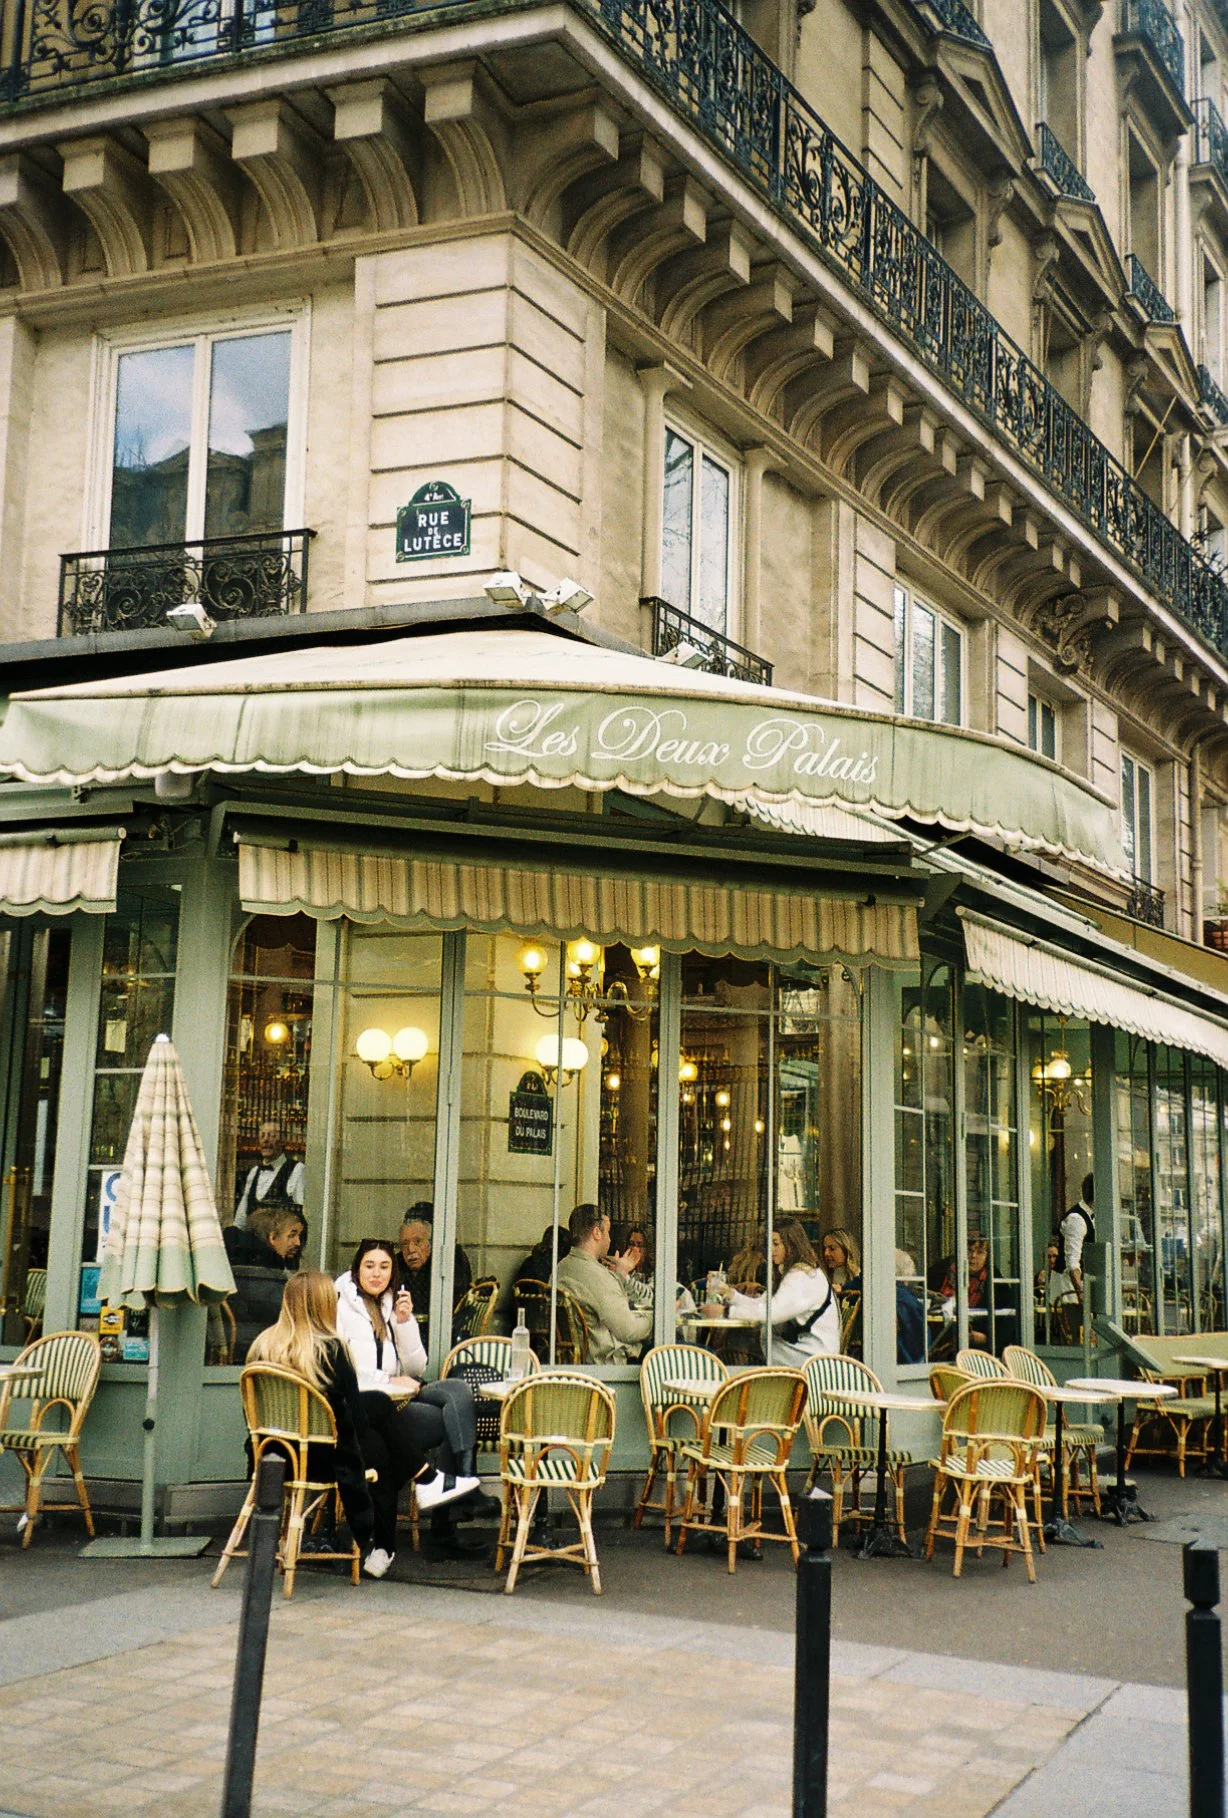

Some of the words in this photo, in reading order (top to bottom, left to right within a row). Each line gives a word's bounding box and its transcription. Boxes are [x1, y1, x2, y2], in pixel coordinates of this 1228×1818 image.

[418, 511, 449, 527] RUE
[428, 527, 439, 535] DE
[485, 700, 580, 757] Les
[590, 706, 729, 766] Deux
[742, 718, 878, 784] Palais
[514, 1107, 549, 1121] BOULEVARD
[515, 1126, 525, 1137] DU
[526, 1127, 547, 1139] PALAIS
